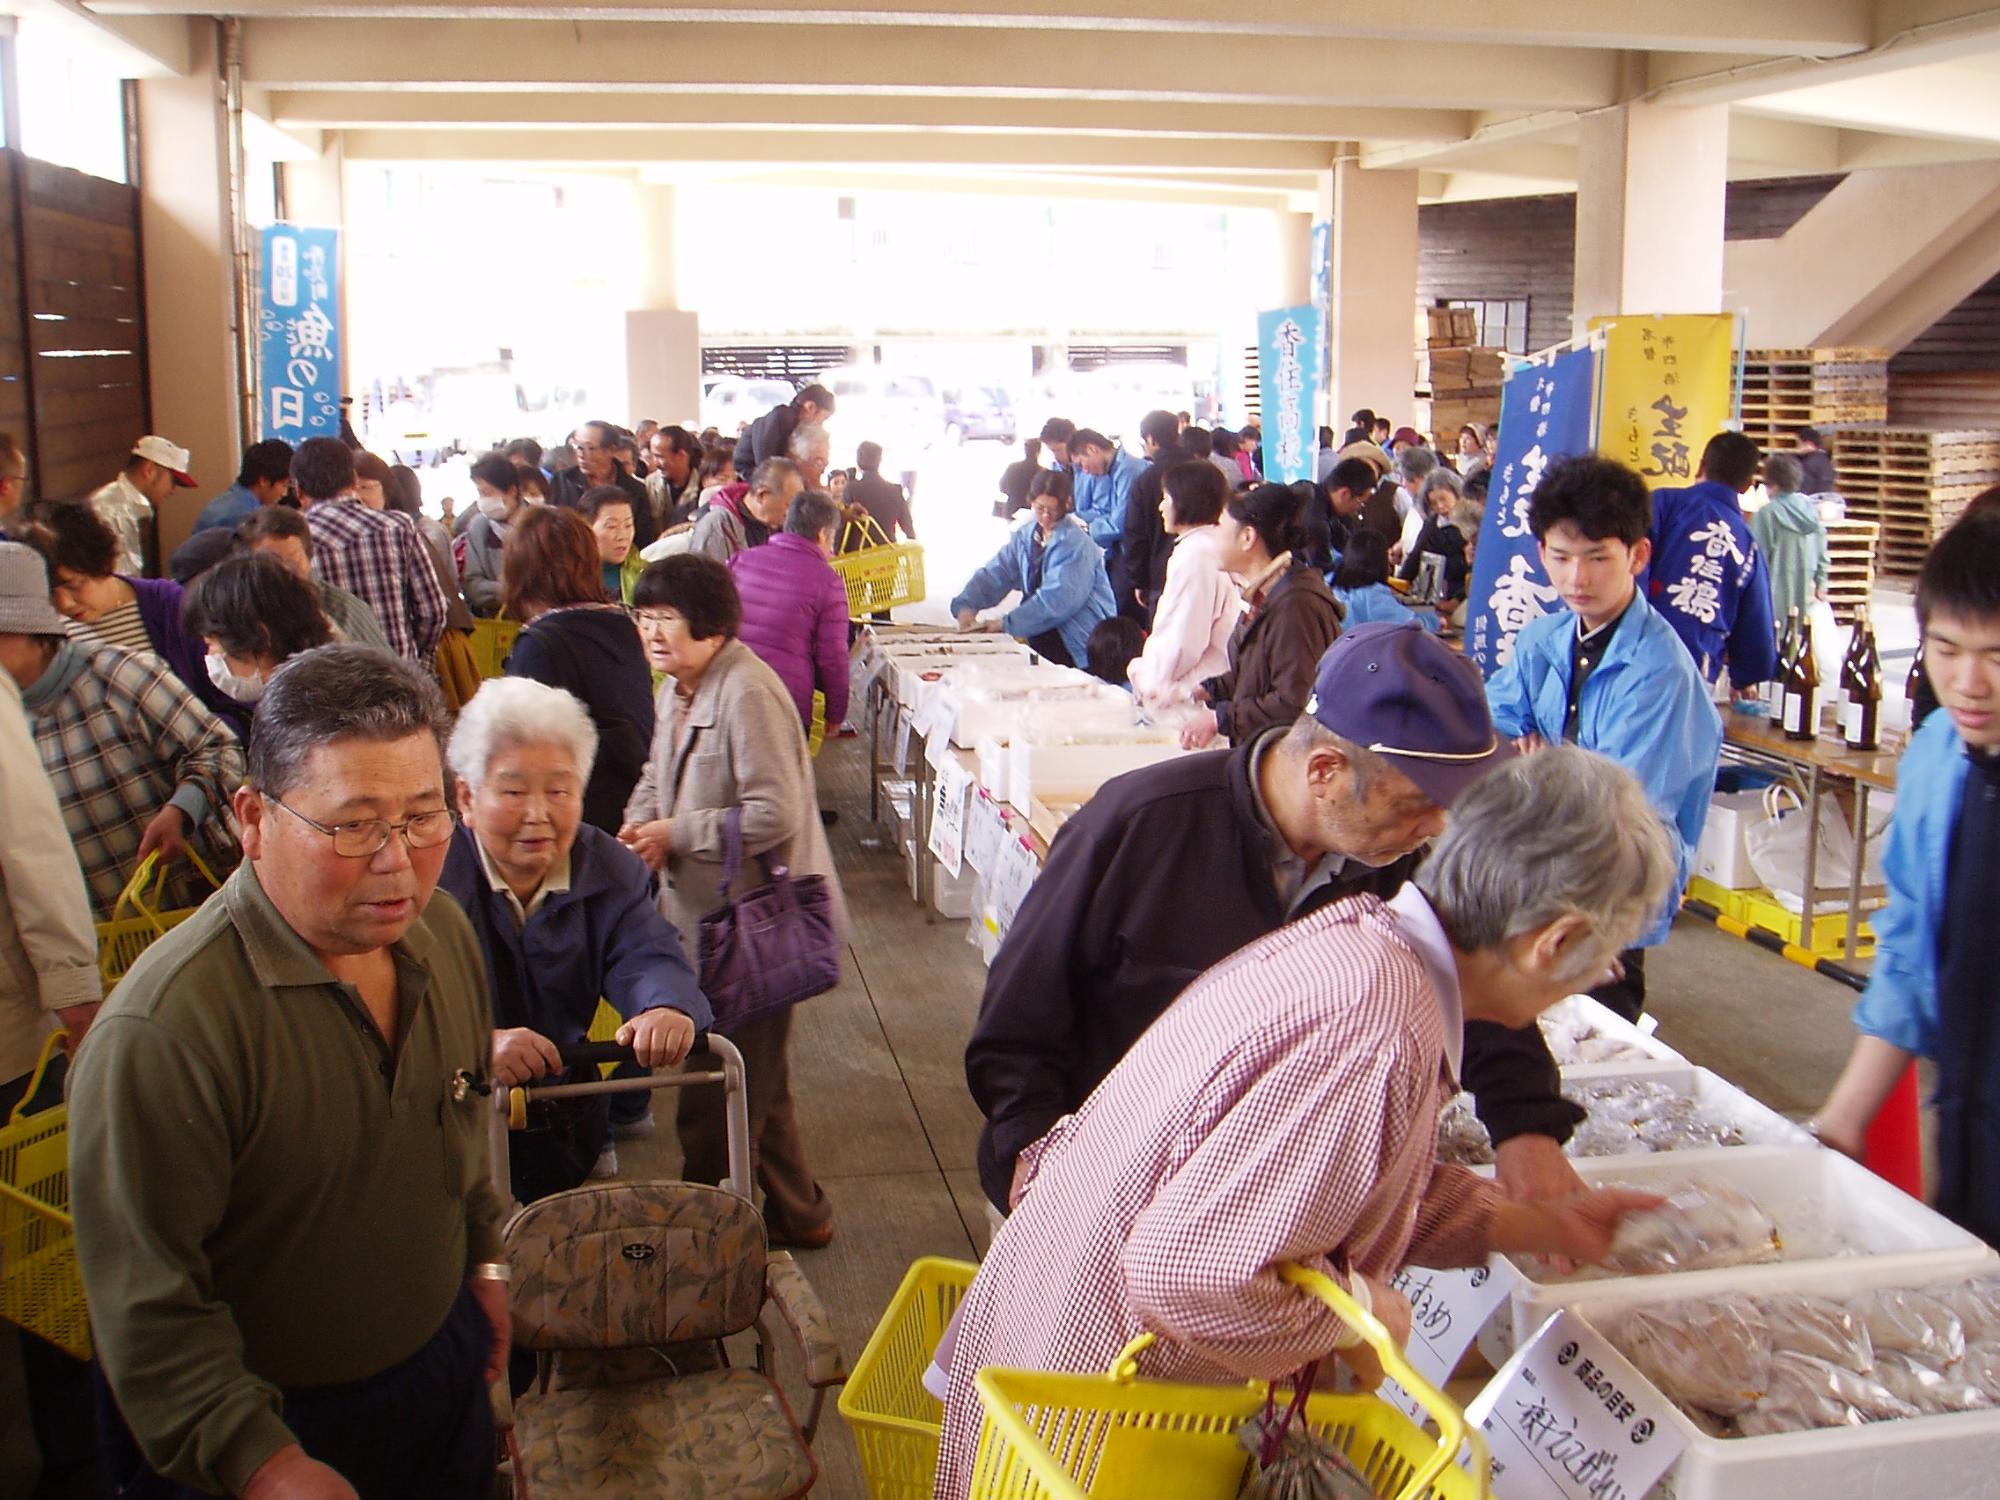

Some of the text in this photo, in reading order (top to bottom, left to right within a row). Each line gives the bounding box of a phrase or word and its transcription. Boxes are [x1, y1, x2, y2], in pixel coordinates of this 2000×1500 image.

[1275, 319, 1304, 484] 香住高校
[1574, 1358, 1637, 1424] 商品の目安
